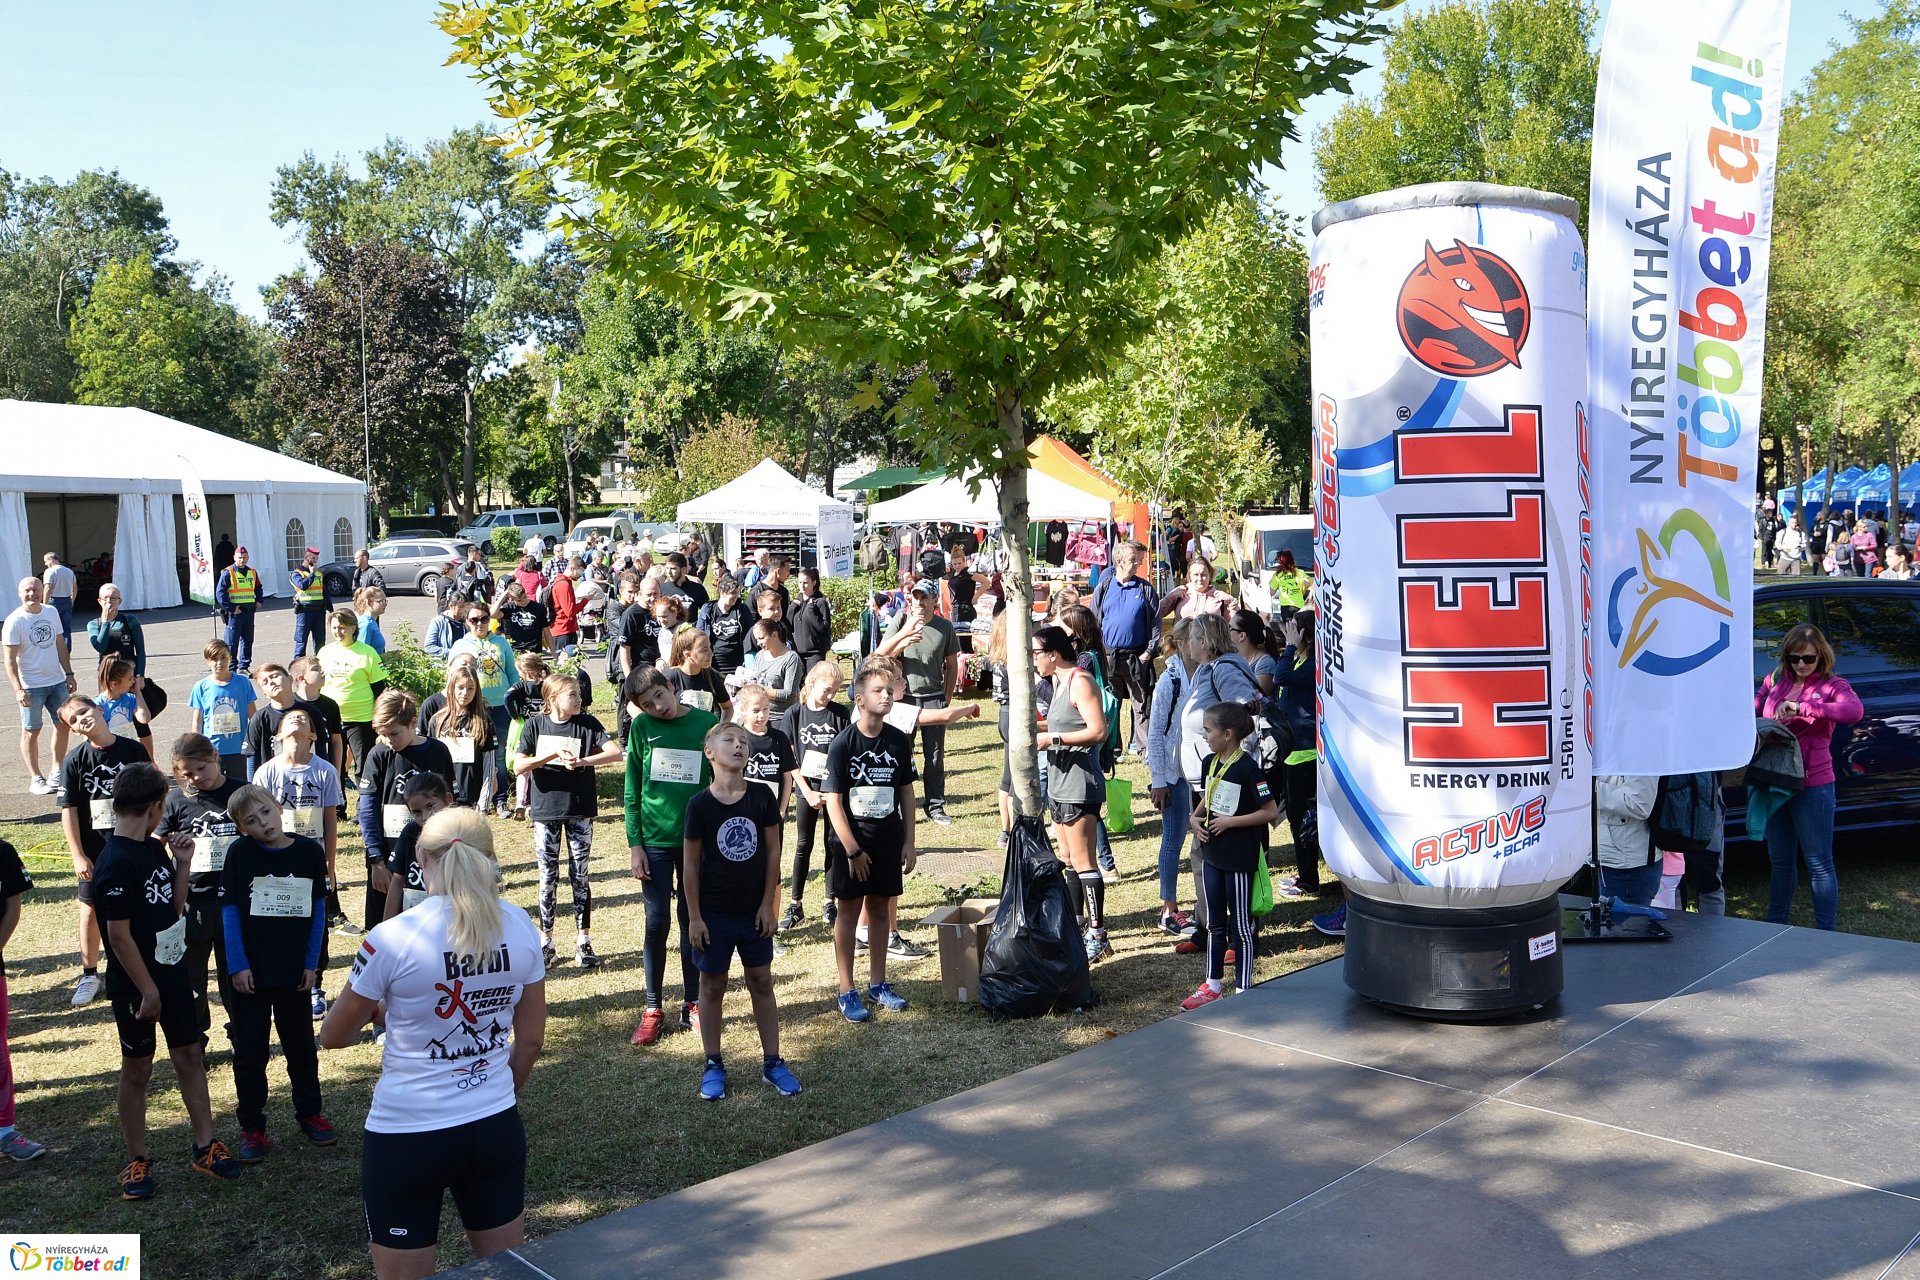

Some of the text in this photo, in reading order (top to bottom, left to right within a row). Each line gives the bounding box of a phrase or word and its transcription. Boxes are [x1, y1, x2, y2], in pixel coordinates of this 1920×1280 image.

[1677, 41, 1764, 488] Többet ad!
[1621, 152, 1671, 484] NYÍREGYHÁZA
[1393, 404, 1553, 767] HELL
[1322, 570, 1333, 697] ENERGY
[1331, 574, 1345, 674] DRINK
[1410, 771, 1550, 789] ENERGY DRINK
[726, 818, 747, 829] CCM
[1414, 797, 1545, 869] ACTIVE
[444, 943, 511, 981] Barbi
[471, 997, 512, 1011] TRAIL
[458, 1073, 488, 1090] OCR
